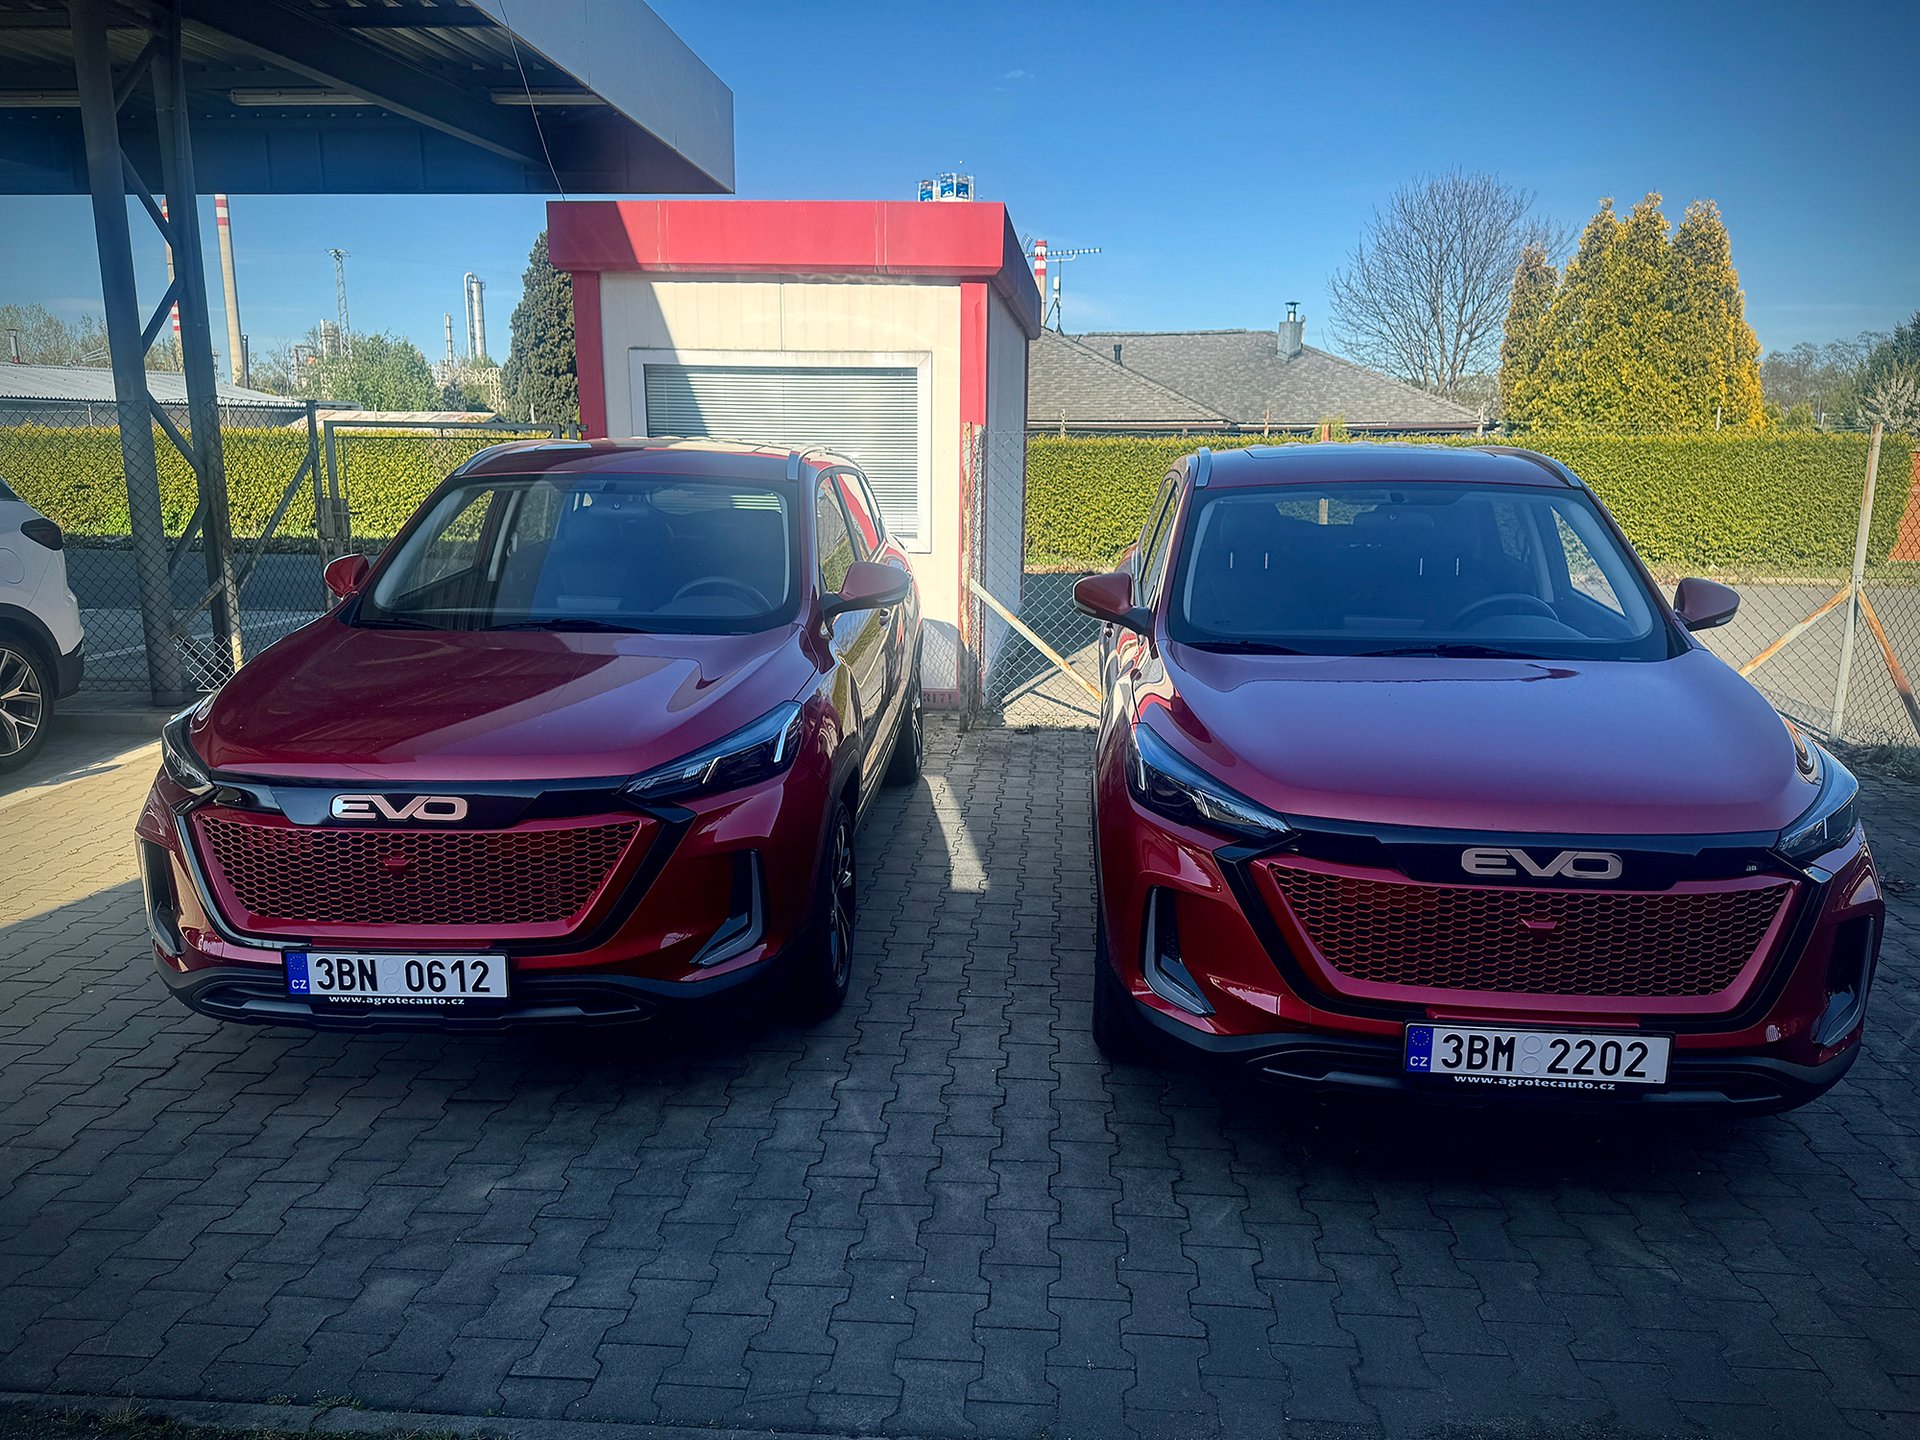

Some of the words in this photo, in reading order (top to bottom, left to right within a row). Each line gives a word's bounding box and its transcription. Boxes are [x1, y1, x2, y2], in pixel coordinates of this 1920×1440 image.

[331, 794, 468, 821] EVO
[1461, 847, 1623, 880] EVO
[291, 980, 307, 990] CZ
[315, 958, 378, 991] 3BN
[404, 960, 491, 993] 0612
[328, 995, 465, 1006] www.agrotecauto.cz
[1409, 1055, 1428, 1067] CZ
[1441, 1033, 1516, 1072] 3BM
[1546, 1038, 1649, 1078] 2202
[1453, 1074, 1616, 1091] www.agrotecauto.cz
